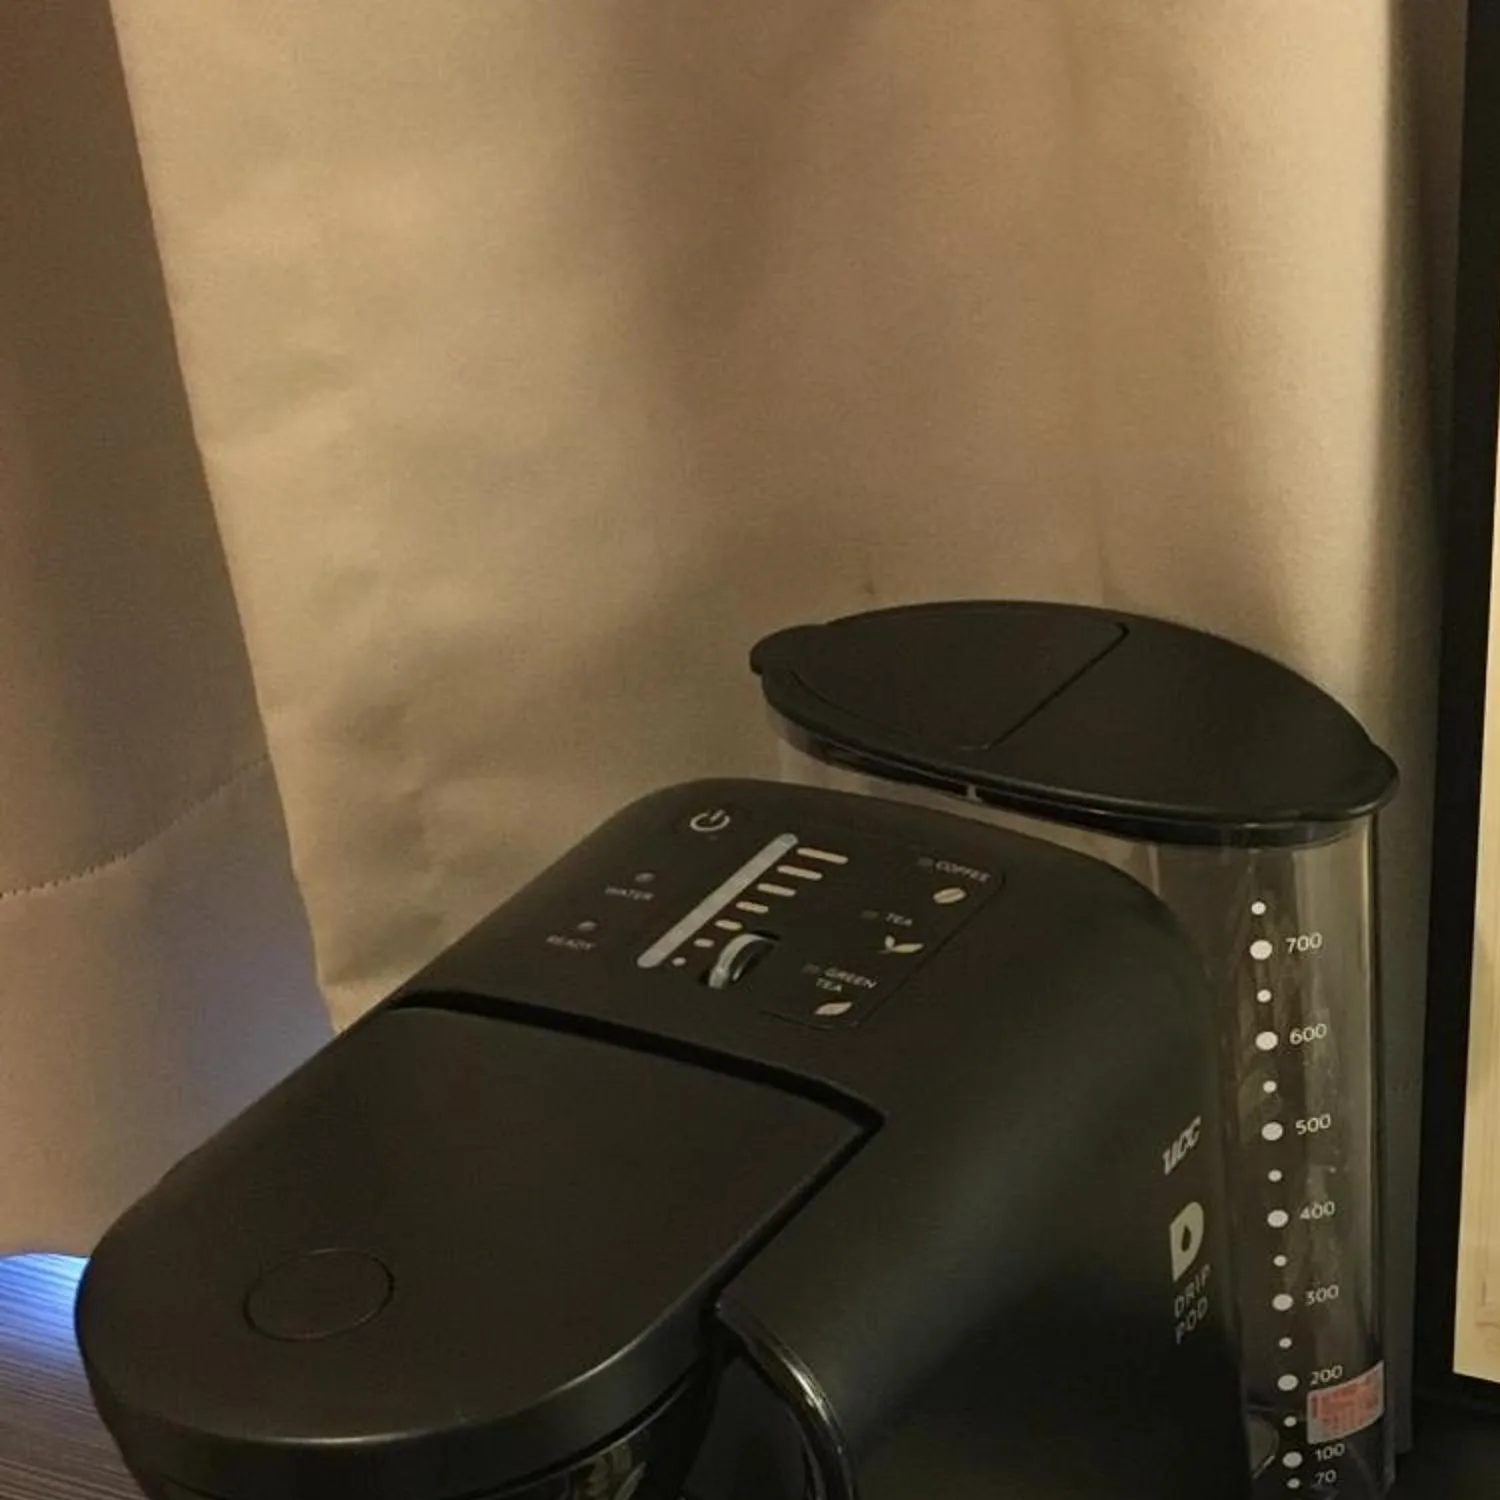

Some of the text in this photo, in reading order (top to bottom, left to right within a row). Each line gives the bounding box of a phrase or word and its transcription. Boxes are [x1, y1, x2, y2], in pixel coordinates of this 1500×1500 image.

[936, 859, 992, 883] COFFEE
[1285, 932, 1323, 954] 700
[824, 966, 878, 989] GREEN
[1289, 1023, 1328, 1045] 600
[1295, 1113, 1332, 1135] 500
[1301, 1200, 1336, 1221] 400
[1305, 1284, 1340, 1305] 300
[1310, 1365, 1344, 1386] 200
[1314, 1443, 1345, 1462] 100
[1315, 1469, 1337, 1486] 70
